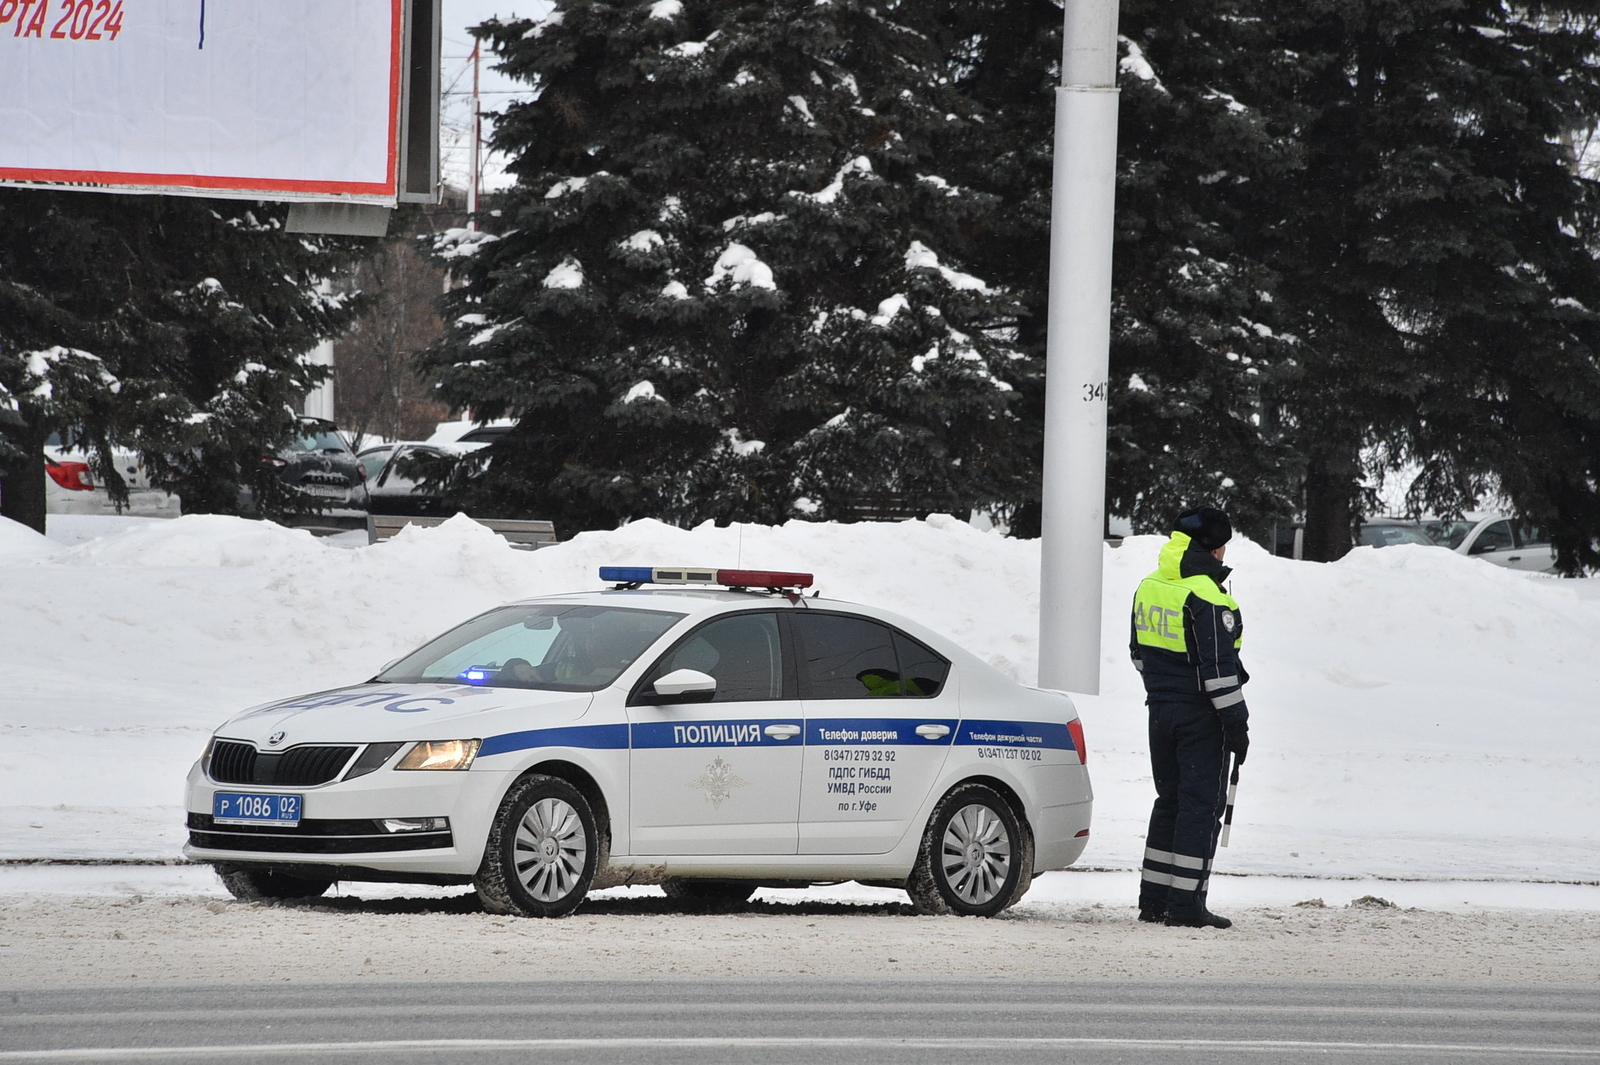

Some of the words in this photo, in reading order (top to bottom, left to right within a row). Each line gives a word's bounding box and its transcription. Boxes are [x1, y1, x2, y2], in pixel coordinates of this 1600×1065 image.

[50, 0, 124, 41] 2024
[1135, 602, 1180, 640] ДПС
[673, 724, 761, 746] ПОЛИЦИЯ
[818, 728, 859, 742] Телефон
[861, 730, 898, 743] доверия
[969, 731, 996, 742] Телефон
[997, 734, 1025, 744] дежурной
[1026, 736, 1043, 744] части
[854, 750, 870, 762] 279
[872, 750, 883, 762] 32
[885, 750, 896, 762] 92
[1005, 748, 1018, 760] 237
[1020, 749, 1031, 761] 02
[1031, 750, 1042, 761] 02
[828, 767, 856, 780] ПДПС
[858, 767, 891, 780] ГИБДД
[827, 782, 856, 795] УМВД
[858, 782, 892, 794] России
[236, 796, 271, 817] 1086
[280, 797, 296, 813] 02
[838, 802, 849, 811] по
[859, 800, 877, 812] Уфе
